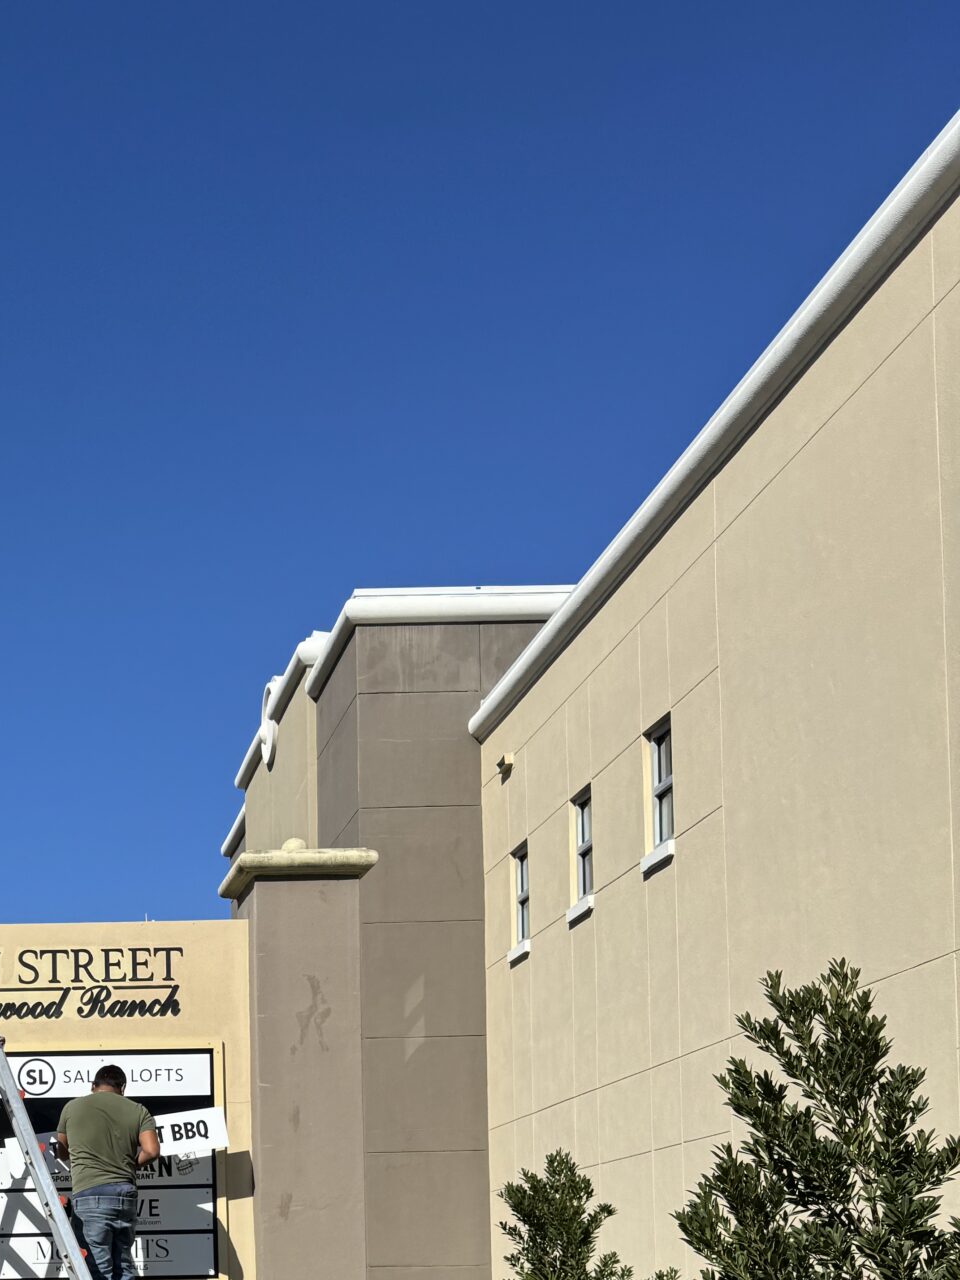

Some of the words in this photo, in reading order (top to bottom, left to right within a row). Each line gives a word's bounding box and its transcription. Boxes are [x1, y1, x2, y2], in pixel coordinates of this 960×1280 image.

[18, 947, 184, 985] STREET
[77, 984, 181, 1019] Ranch
[26, 1068, 49, 1086] SL
[63, 1069, 95, 1084] SAL
[131, 1068, 184, 1083] LOFTS
[170, 1119, 209, 1142] BBQ
